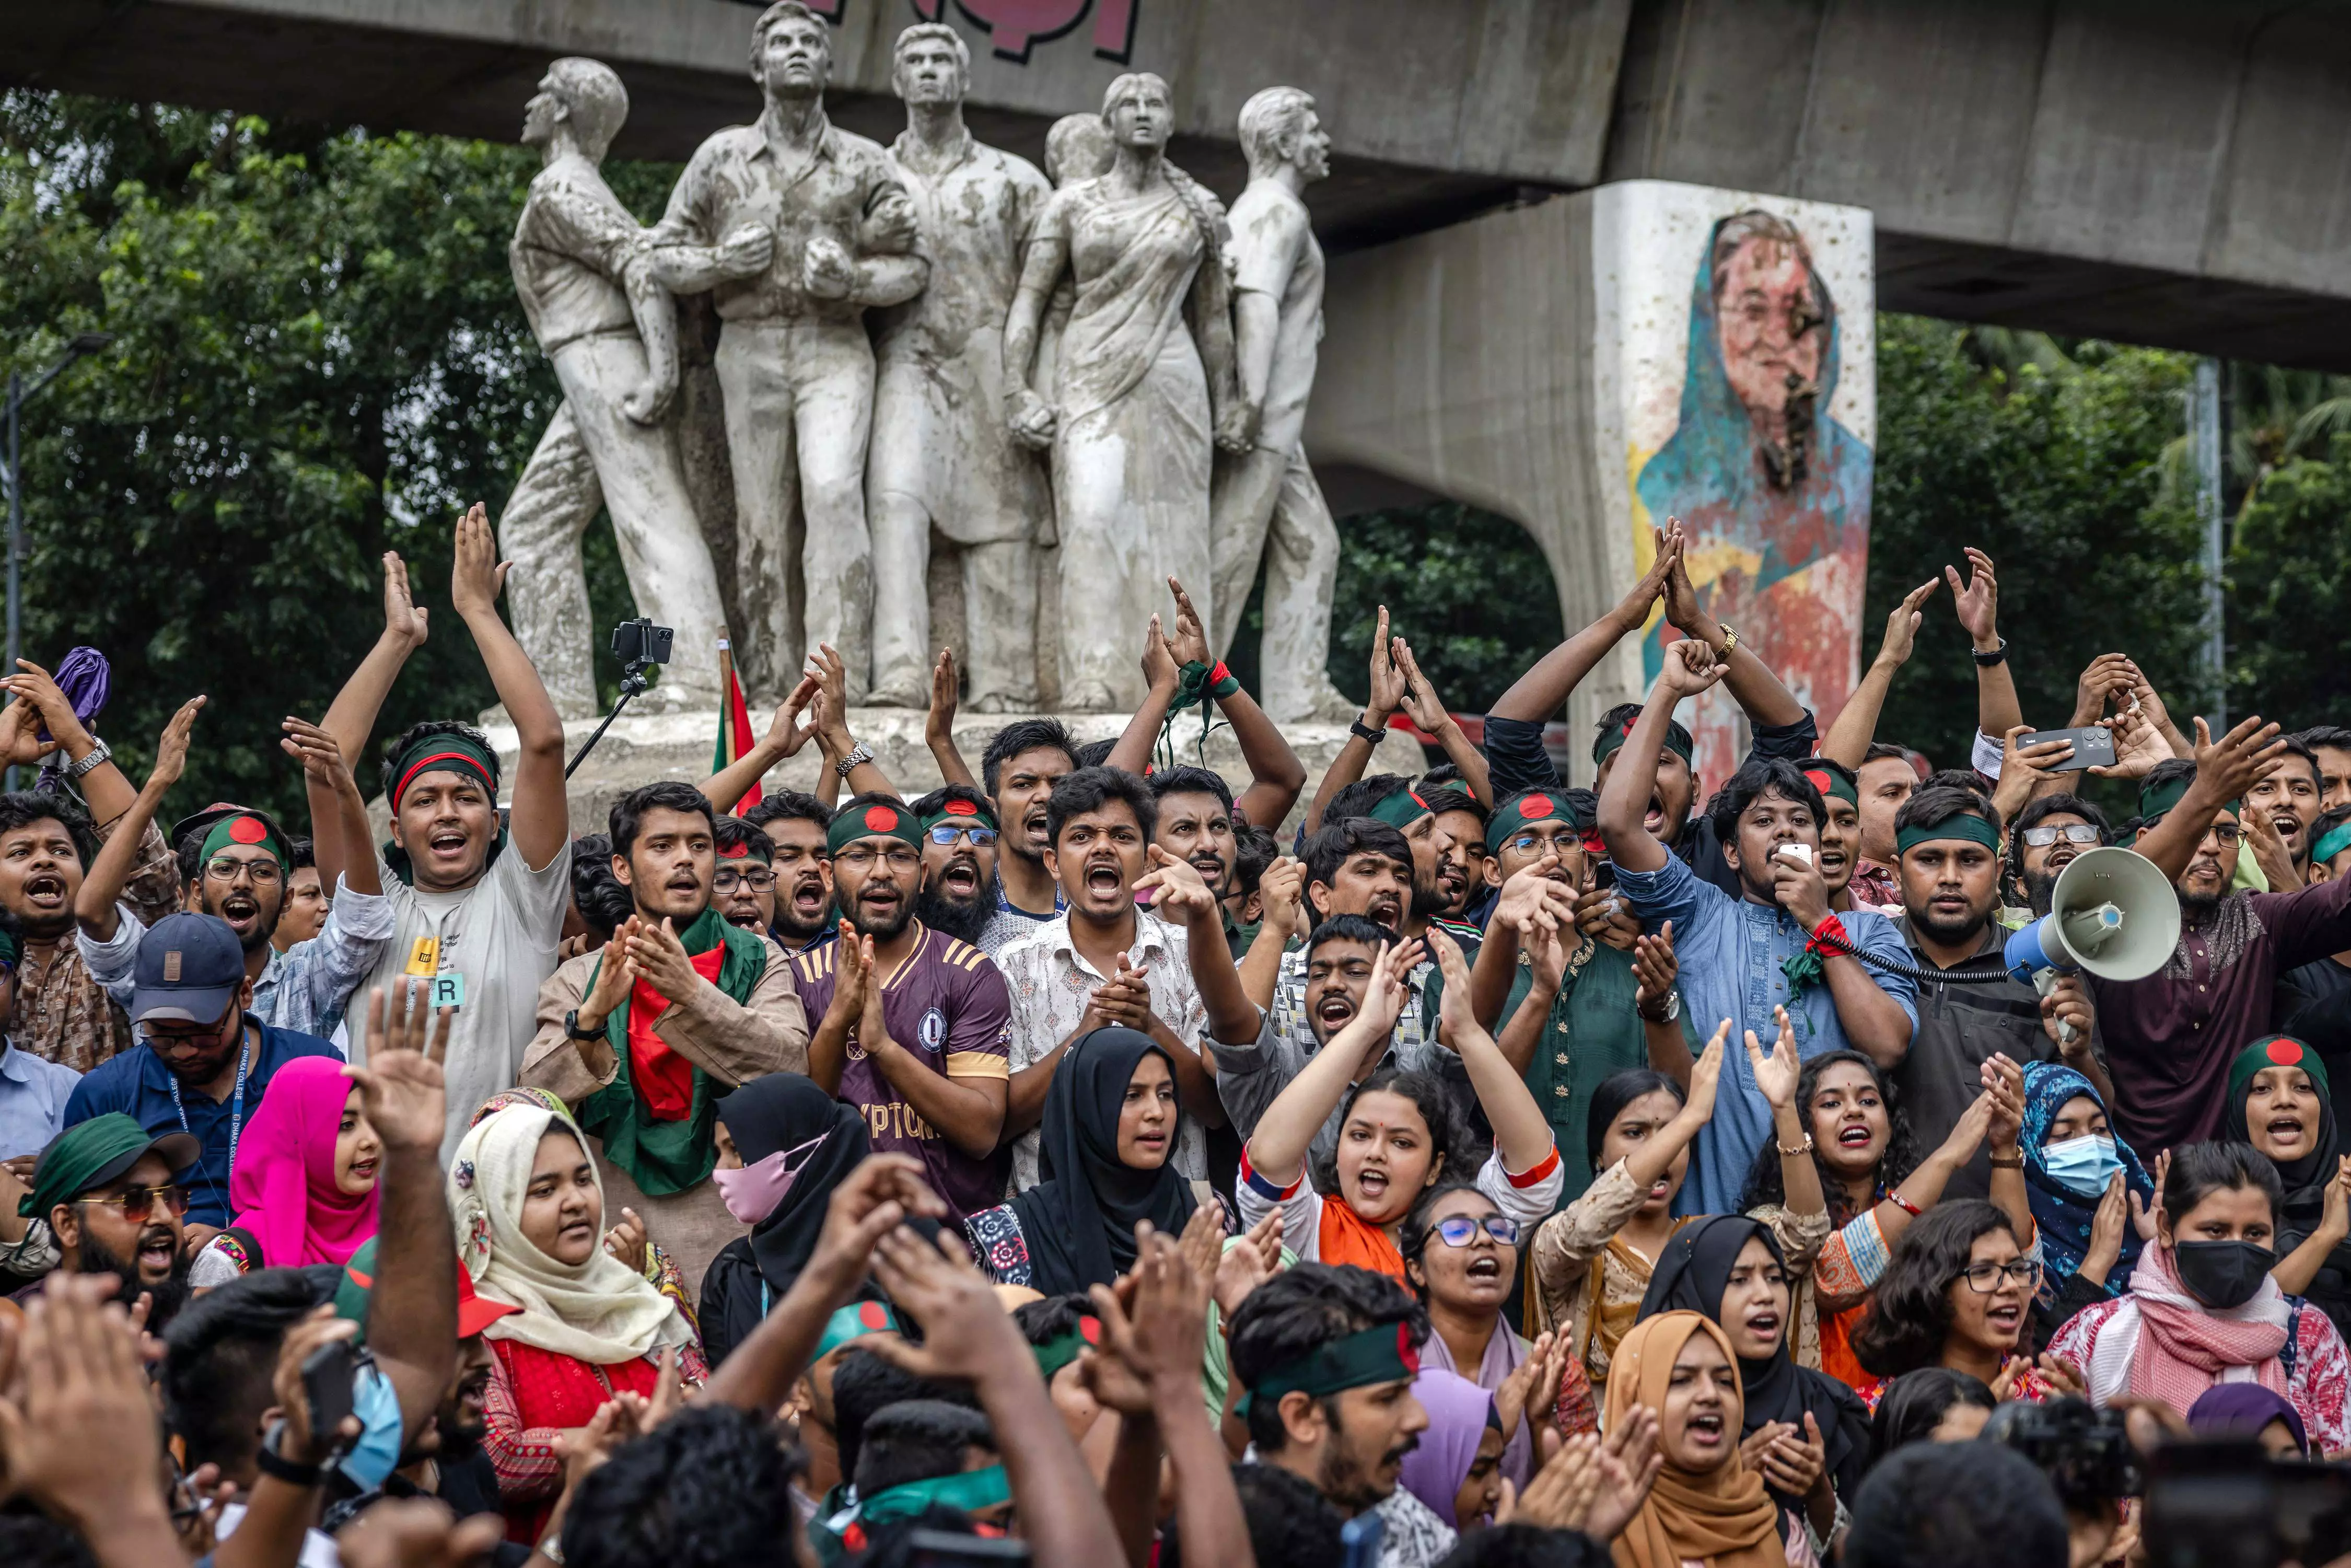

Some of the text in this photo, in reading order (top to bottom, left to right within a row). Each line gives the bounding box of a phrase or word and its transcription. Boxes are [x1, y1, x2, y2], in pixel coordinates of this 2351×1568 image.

[438, 979, 455, 1001] R
[235, 1049, 248, 1100] DHAKA COLLEGE
[179, 1107, 188, 1129] DHAKA
